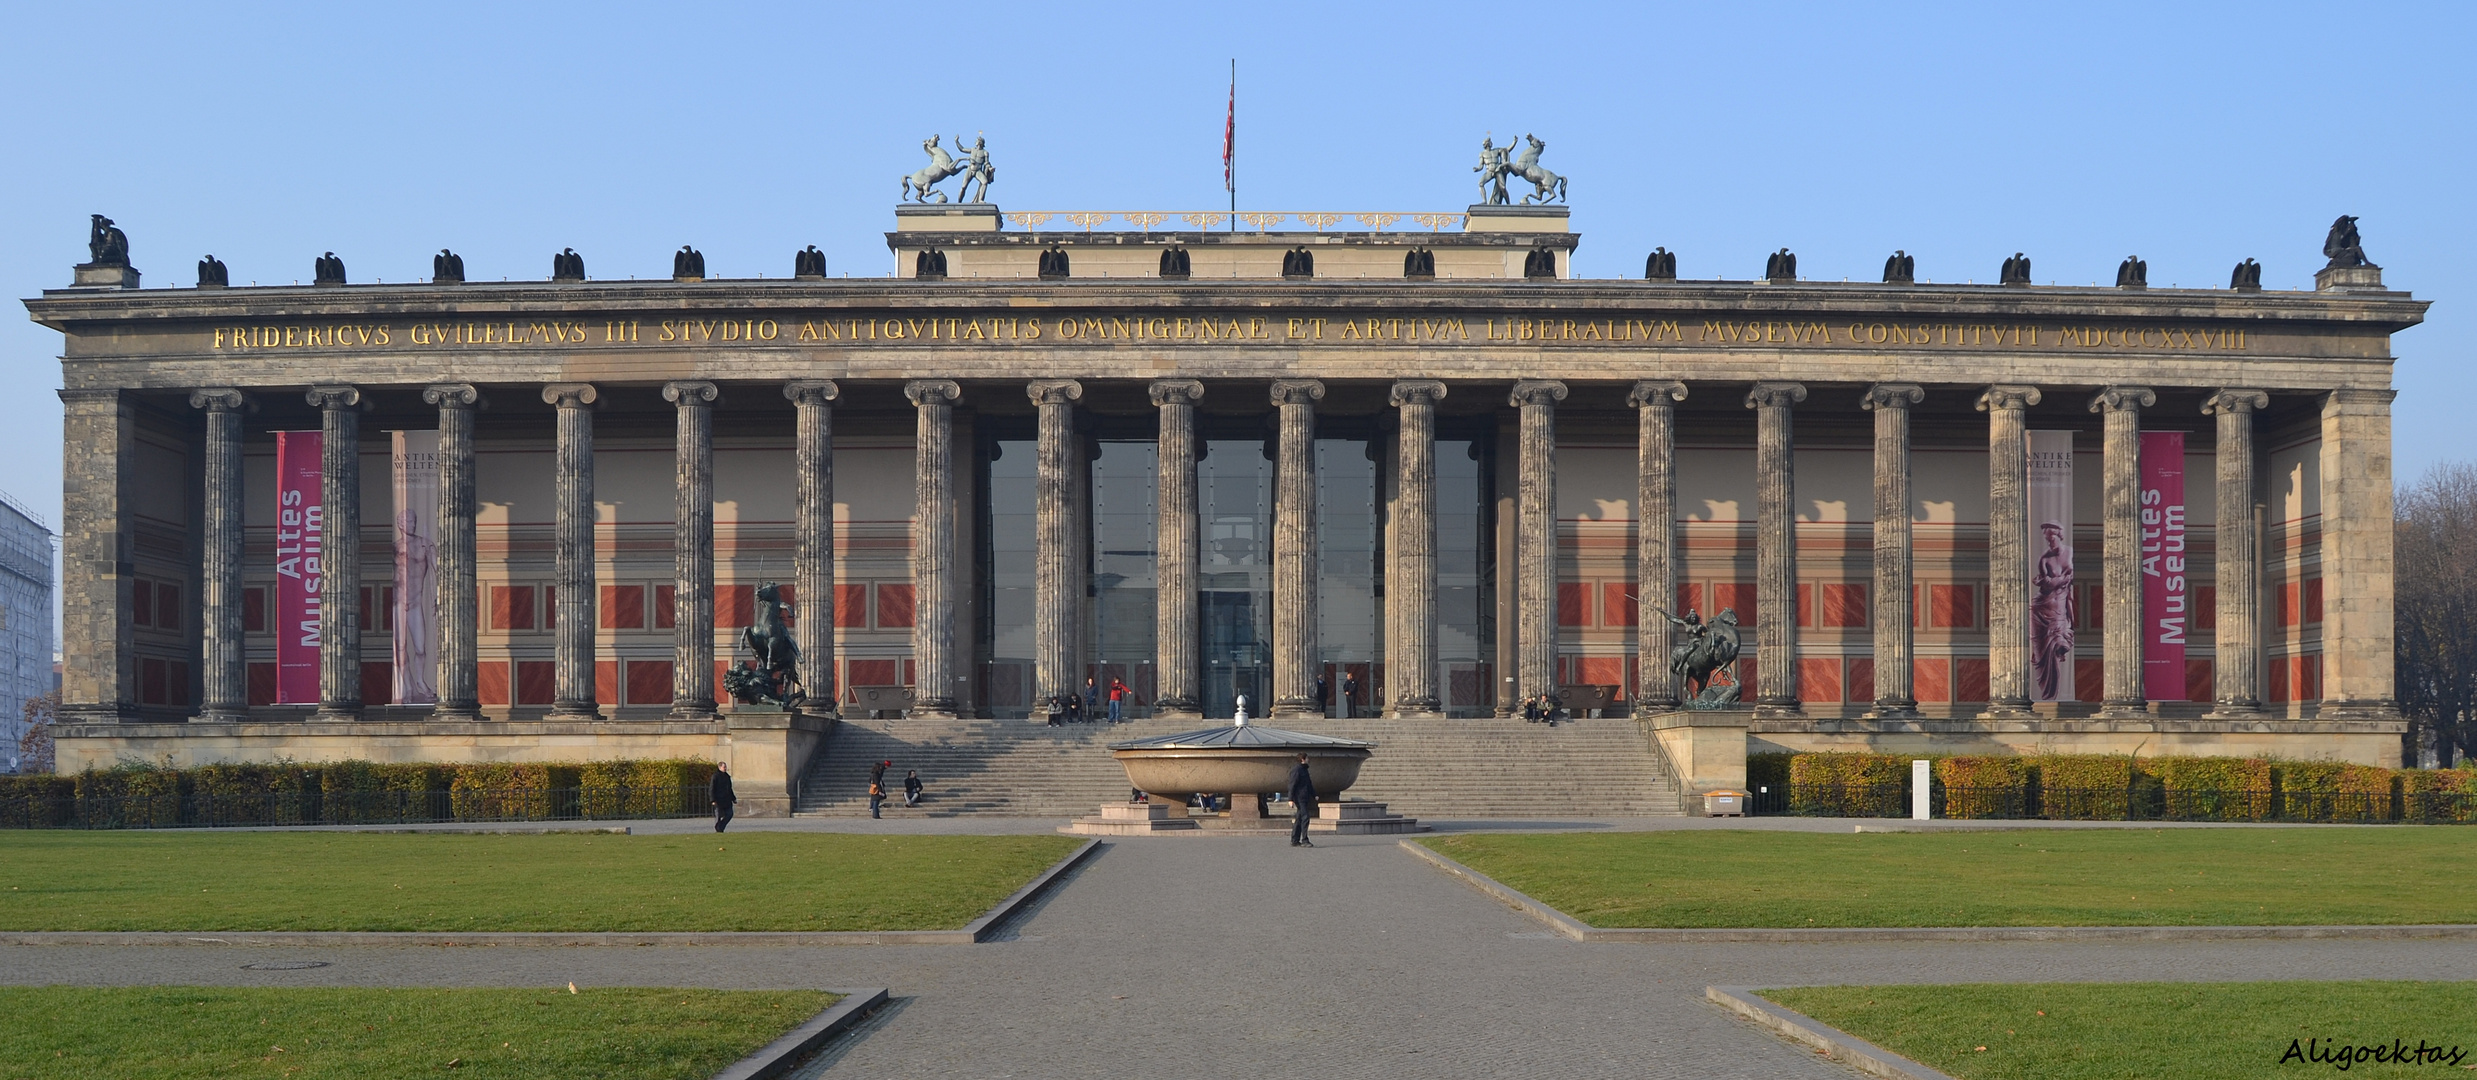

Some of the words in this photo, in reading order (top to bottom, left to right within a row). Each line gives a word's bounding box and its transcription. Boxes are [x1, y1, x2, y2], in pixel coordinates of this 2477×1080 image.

[213, 325, 391, 350] FRIDERICVS
[411, 322, 587, 345] GVILELMVS
[604, 321, 640, 343] III
[657, 319, 779, 342] STVDIO
[798, 318, 1042, 342] ANTIQVITATIS
[1058, 318, 1270, 342] OMNIGENAE
[1286, 318, 1328, 341] ET
[1341, 318, 1469, 342] ARTIVM
[1486, 319, 1684, 343] LIBERALIVM
[1697, 321, 1833, 344] MVSEVM
[1848, 324, 2044, 347] CONSTITVIT
[2058, 327, 2247, 350] MDCCCXXVIII
[277, 489, 301, 579] Altes
[2142, 488, 2161, 577] Altes
[2160, 505, 2185, 644] Museum
